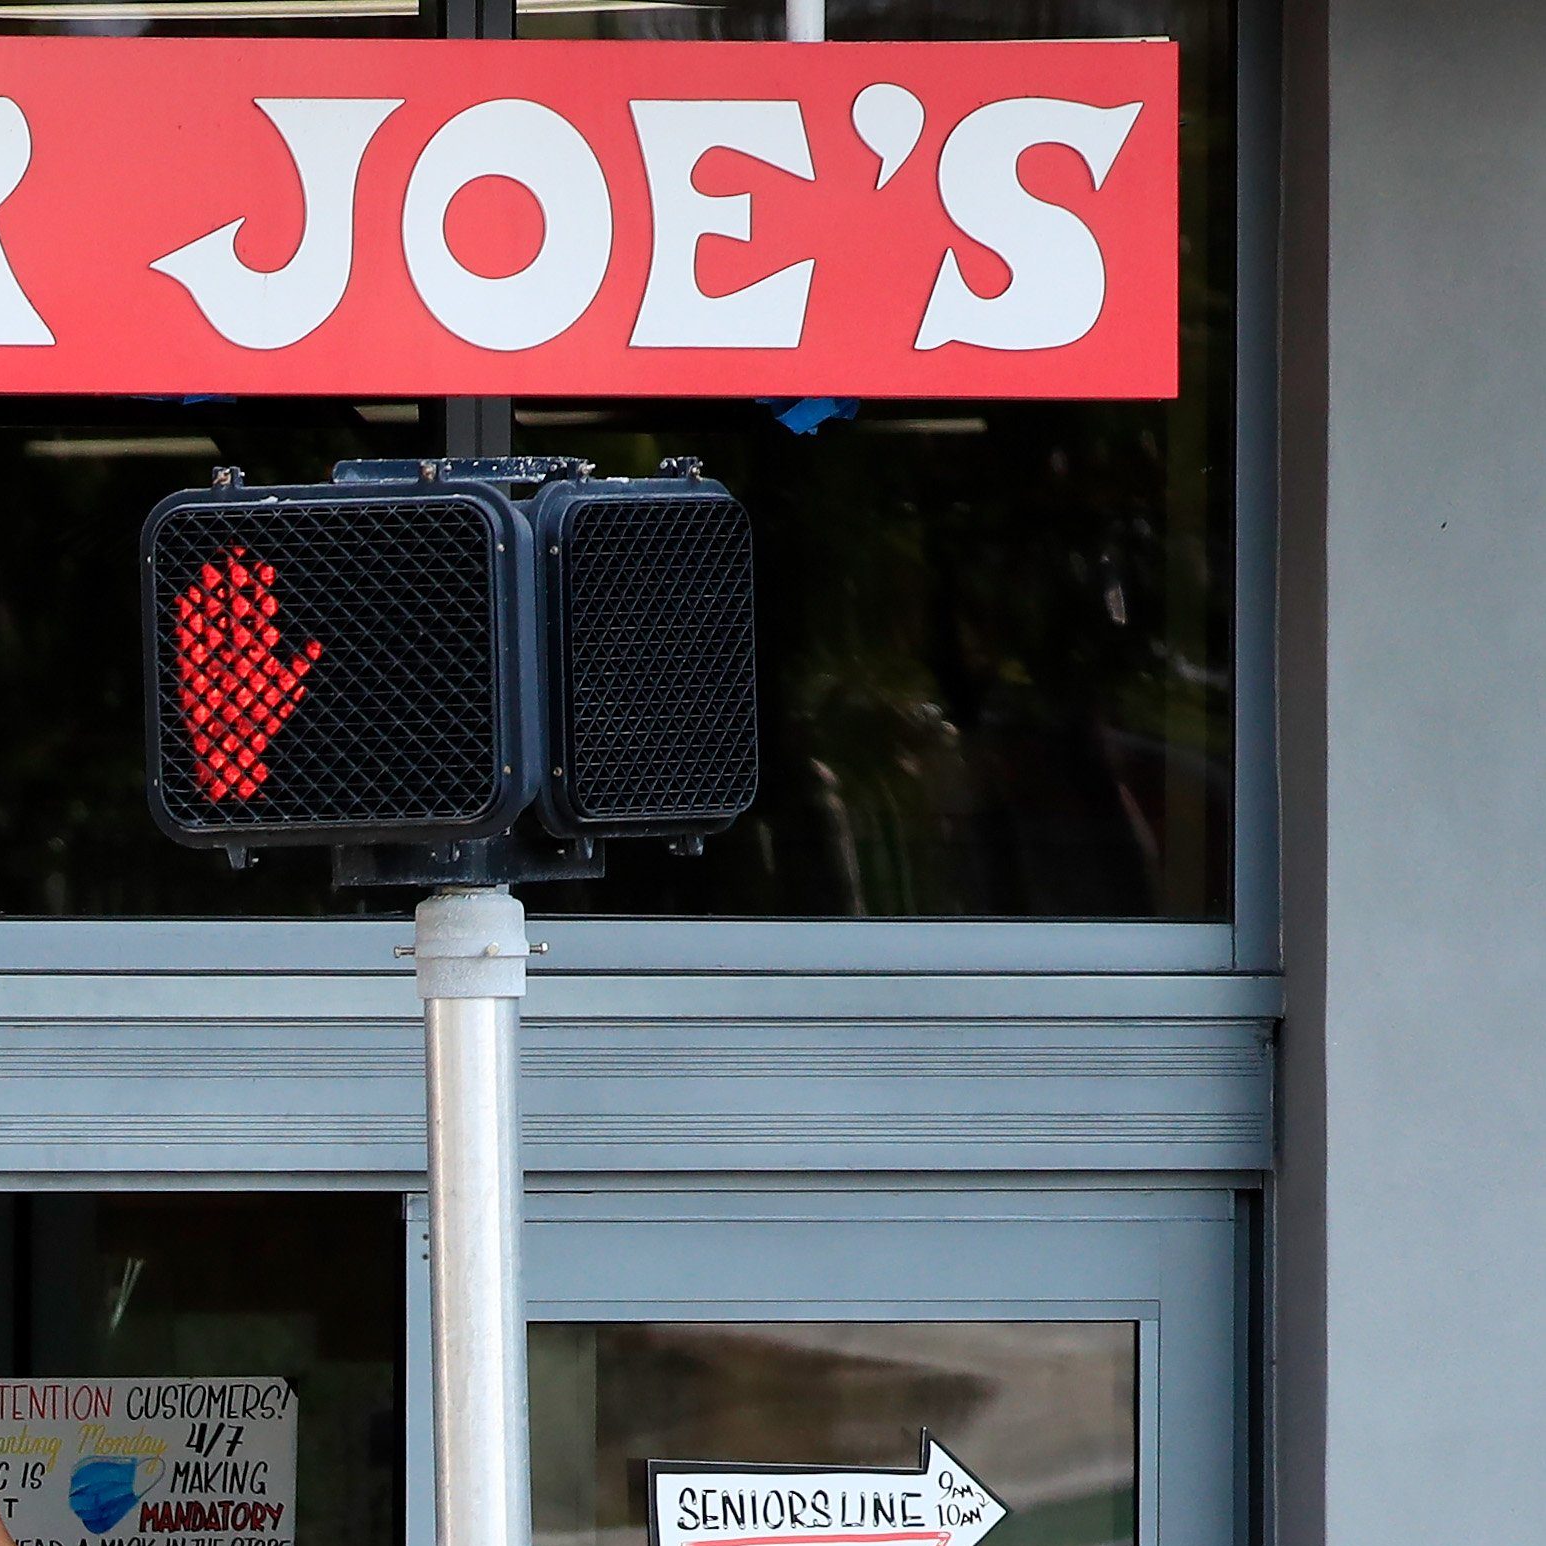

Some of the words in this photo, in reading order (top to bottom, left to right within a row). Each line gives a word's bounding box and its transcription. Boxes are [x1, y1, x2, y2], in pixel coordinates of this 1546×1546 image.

[149, 81, 1144, 351] JOE'S
[127, 1383, 291, 1420] CUSTOMERS!
[76, 1424, 167, 1473] Monday
[185, 1421, 244, 1458] 4/7
[21, 1462, 46, 1489] IS
[170, 1460, 270, 1495] MAKING
[139, 1500, 285, 1533] MANDATORY
[677, 1488, 833, 1532] SENIORS
[840, 1490, 926, 1529] LINE
